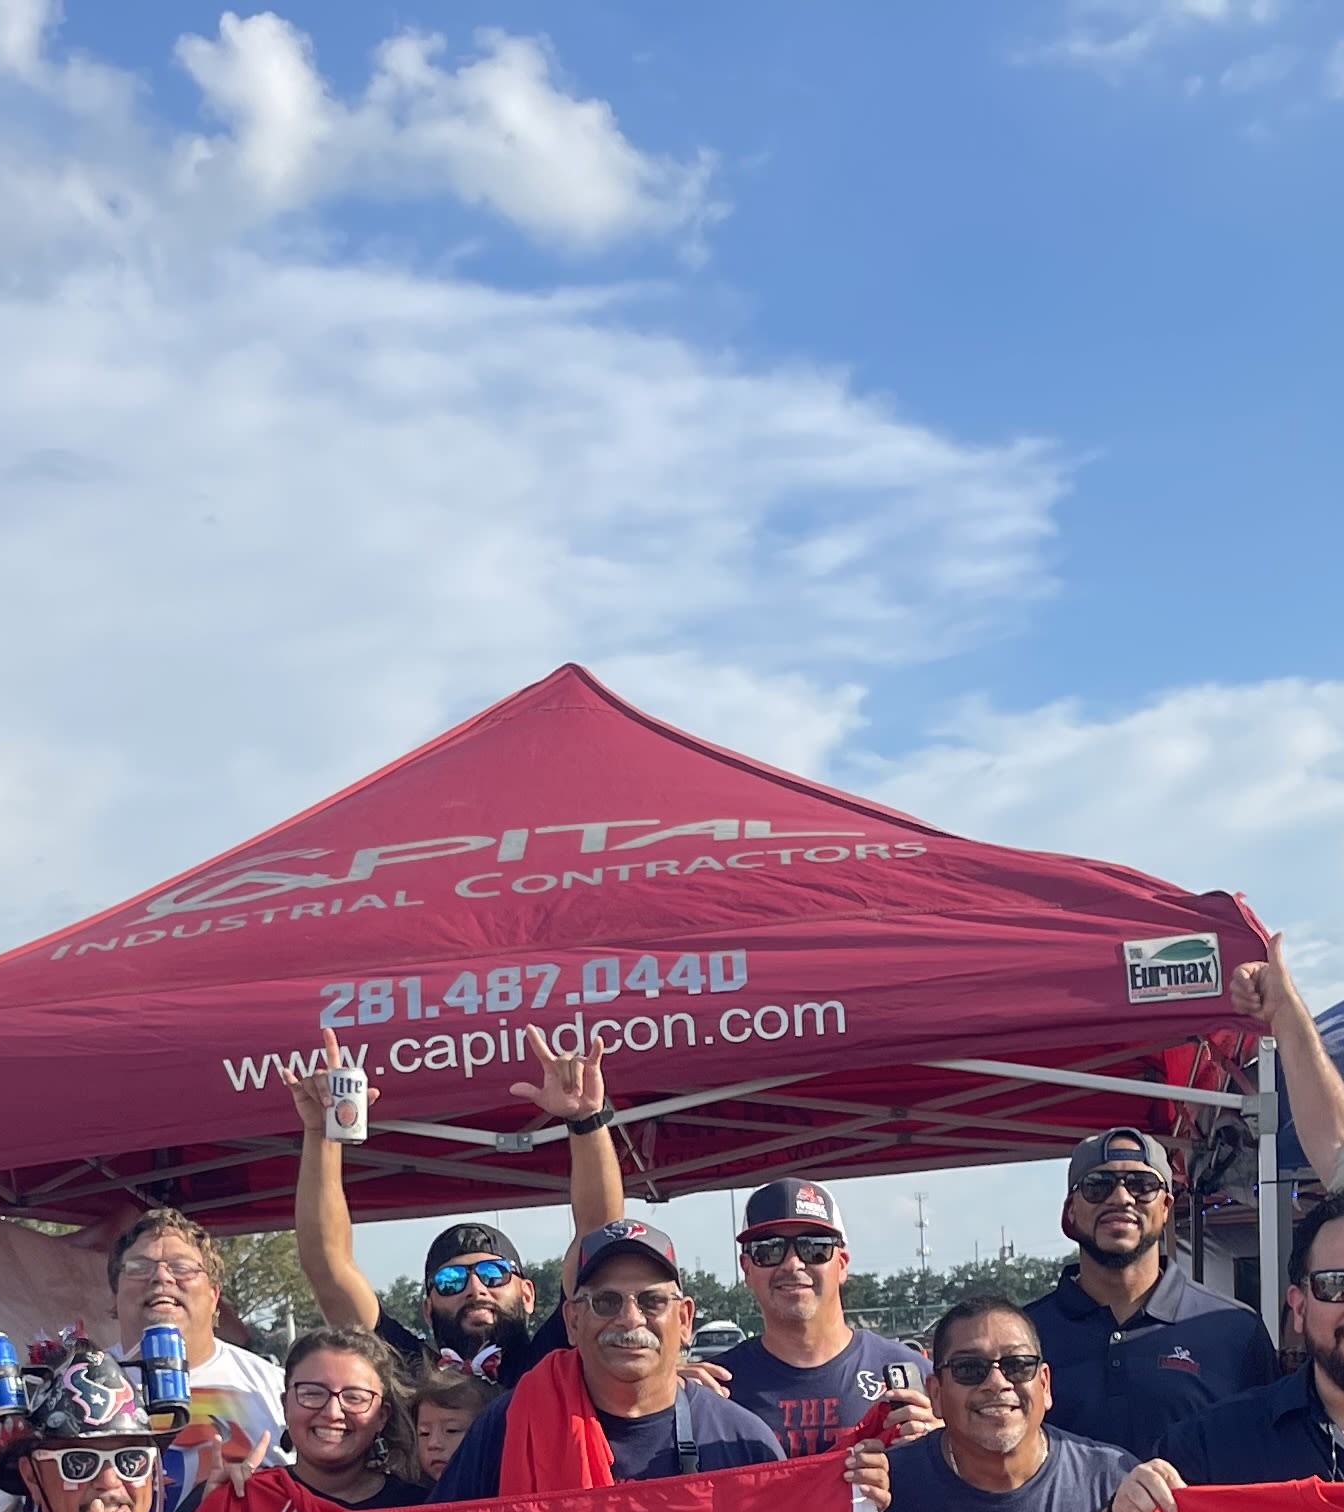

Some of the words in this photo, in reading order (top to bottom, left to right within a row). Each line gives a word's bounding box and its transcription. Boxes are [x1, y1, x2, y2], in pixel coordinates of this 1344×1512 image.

[49, 889, 424, 961] INDUSTRIAL
[454, 841, 928, 898] CONTRACTORS
[319, 948, 748, 1029] 281.487.0440
[1128, 961, 1213, 990] Eurmax
[332, 1076, 363, 1097] Lite
[778, 1398, 840, 1428] THE
